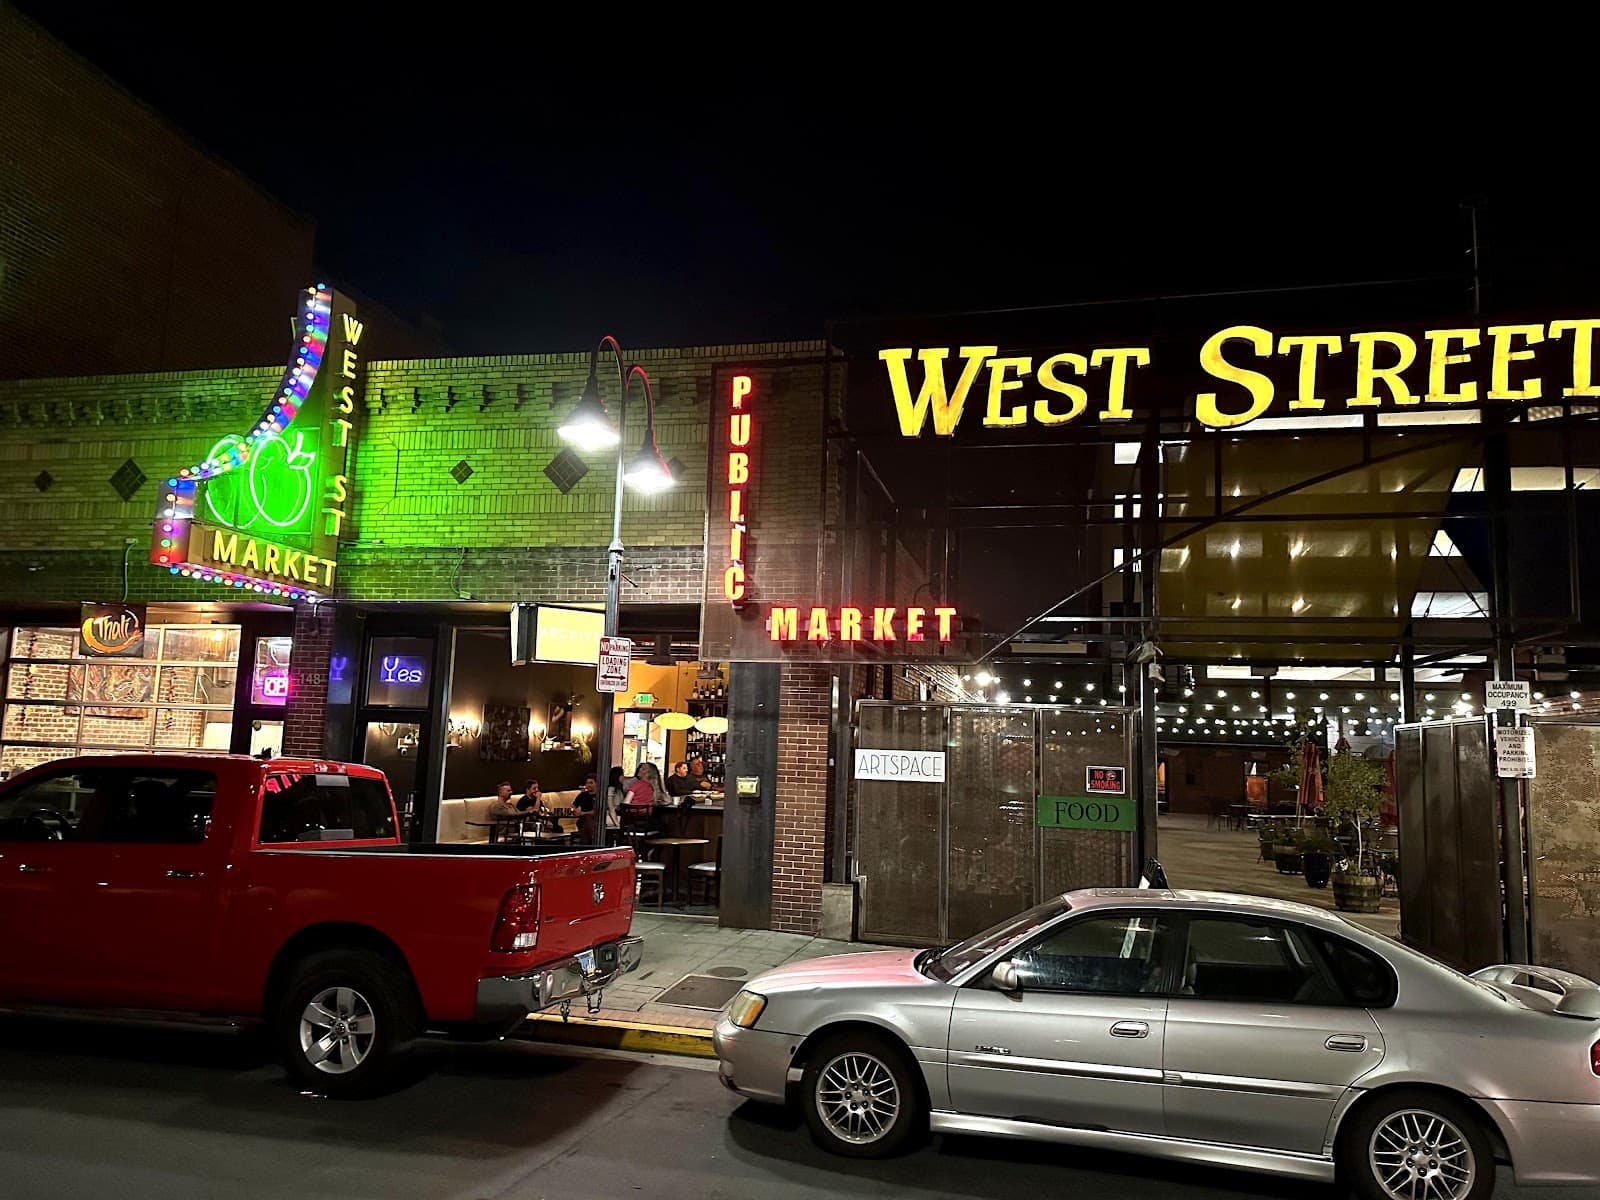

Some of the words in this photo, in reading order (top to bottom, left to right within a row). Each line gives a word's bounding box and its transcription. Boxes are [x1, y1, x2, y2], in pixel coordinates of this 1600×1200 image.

[337, 313, 364, 447] WEST
[879, 345, 1151, 438] WEST
[1195, 319, 1600, 429] STREET
[724, 375, 752, 602] PUBLIC
[328, 475, 348, 537] ST
[213, 530, 337, 587] MARKET
[93, 614, 131, 640] Thali
[768, 607, 957, 642] MARKET
[600, 641, 610, 651] NO
[610, 644, 630, 652] PARKING
[383, 656, 423, 683] Yes
[602, 657, 627, 666] LOADING
[607, 666, 622, 674] ZONE
[300, 673, 321, 685] 148
[1488, 691, 1528, 699] OCCUPANCY
[1501, 699, 1517, 707] 499
[857, 754, 943, 777] ARTSPACE
[1094, 770, 1104, 780] NO
[1090, 780, 1121, 790] SMOKING
[1055, 801, 1120, 825] FOOD
